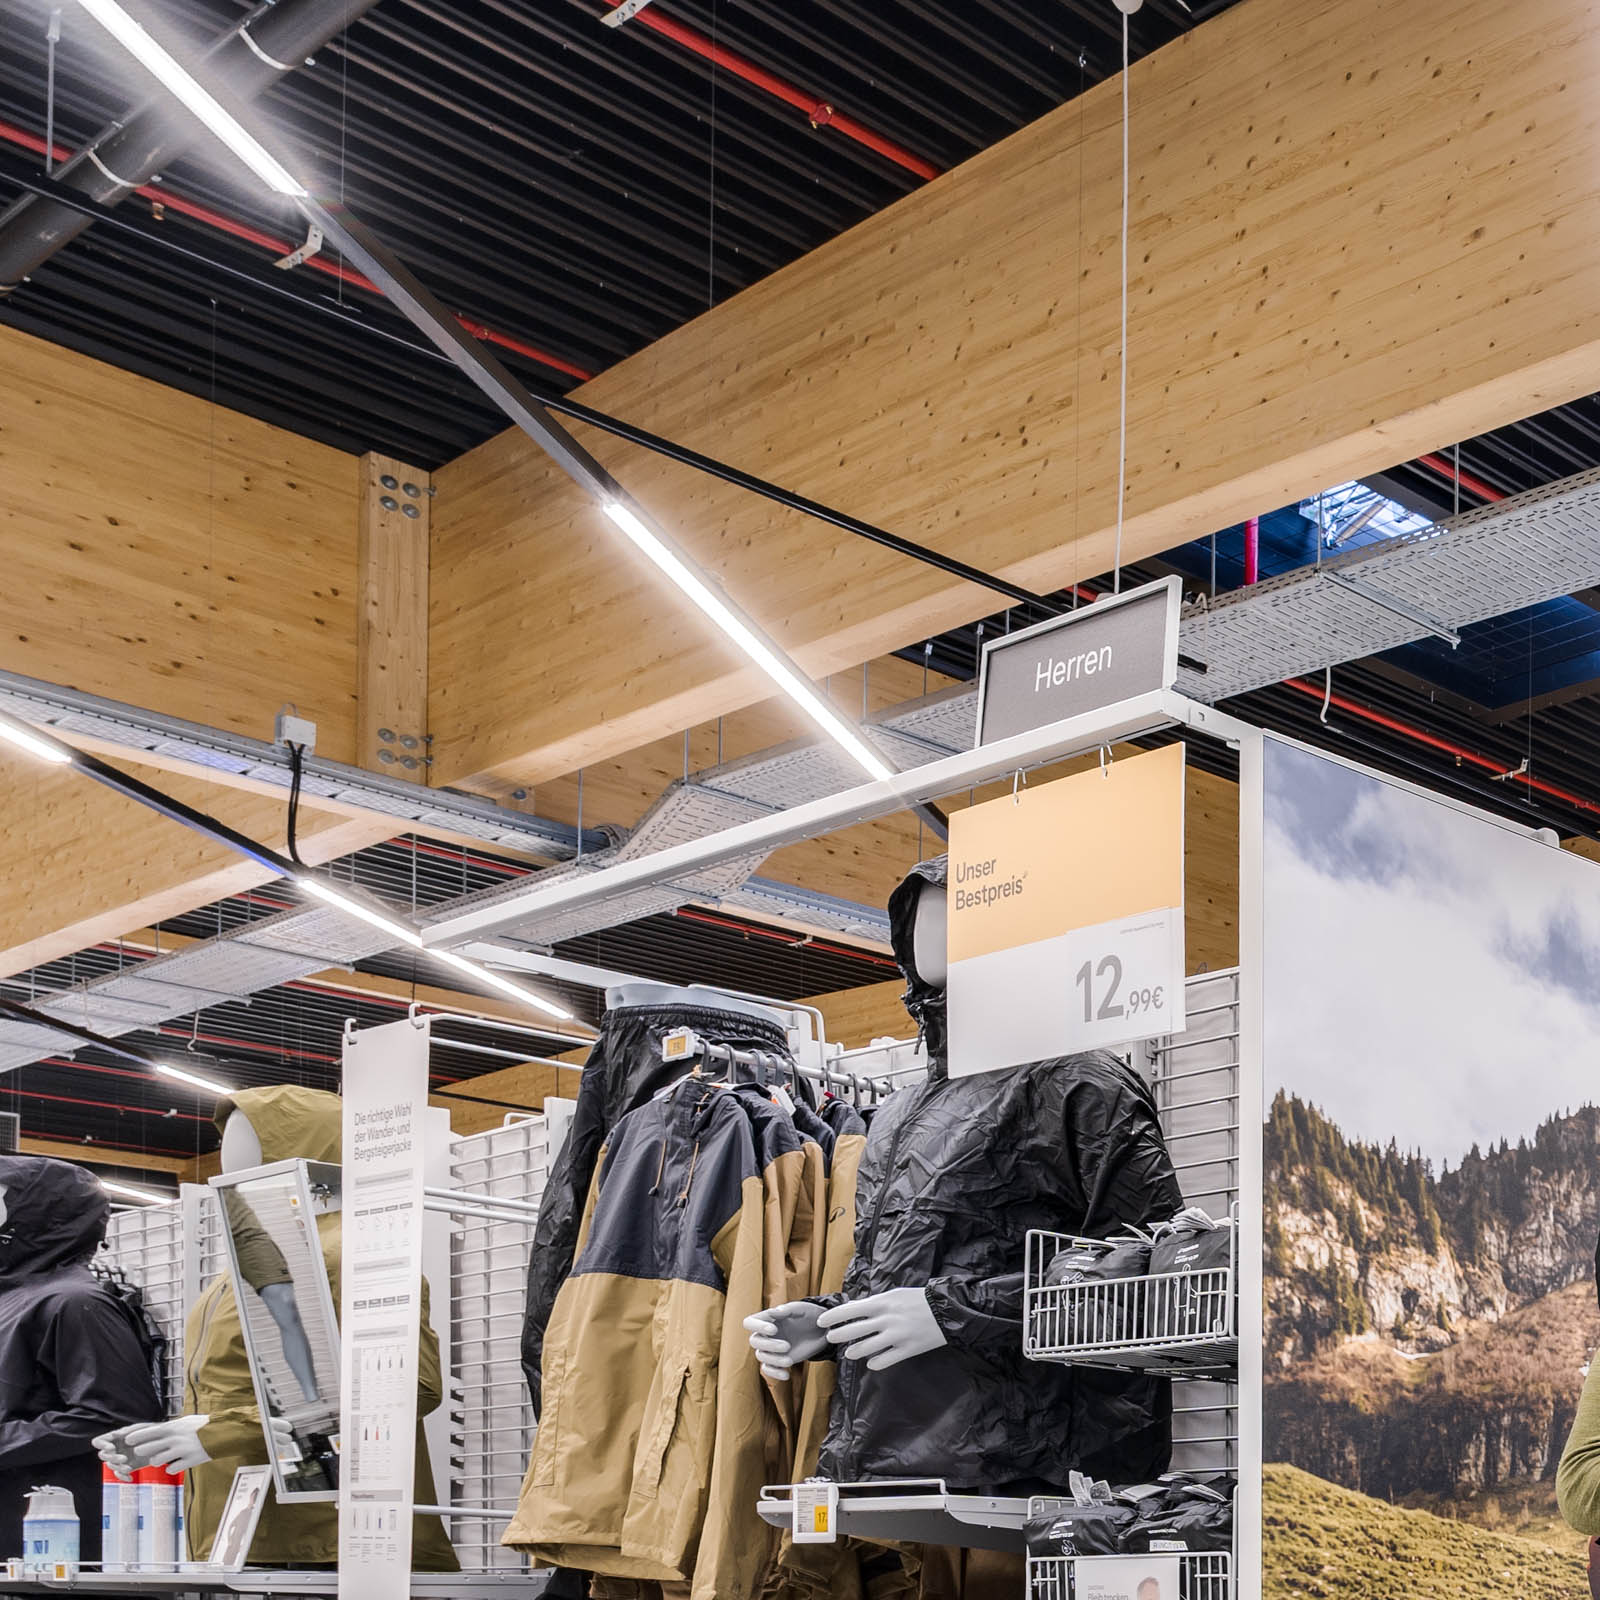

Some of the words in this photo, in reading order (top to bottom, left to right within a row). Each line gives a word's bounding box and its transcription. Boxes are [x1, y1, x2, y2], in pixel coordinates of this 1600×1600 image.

[1034, 645, 1112, 692] Herren
[956, 858, 996, 884] Unser
[955, 875, 1023, 911] Bestpreis
[1076, 954, 1163, 1023] 12,99€
[354, 1112, 366, 1126] Die
[394, 1101, 413, 1117] Wahl
[397, 1119, 411, 1136] und
